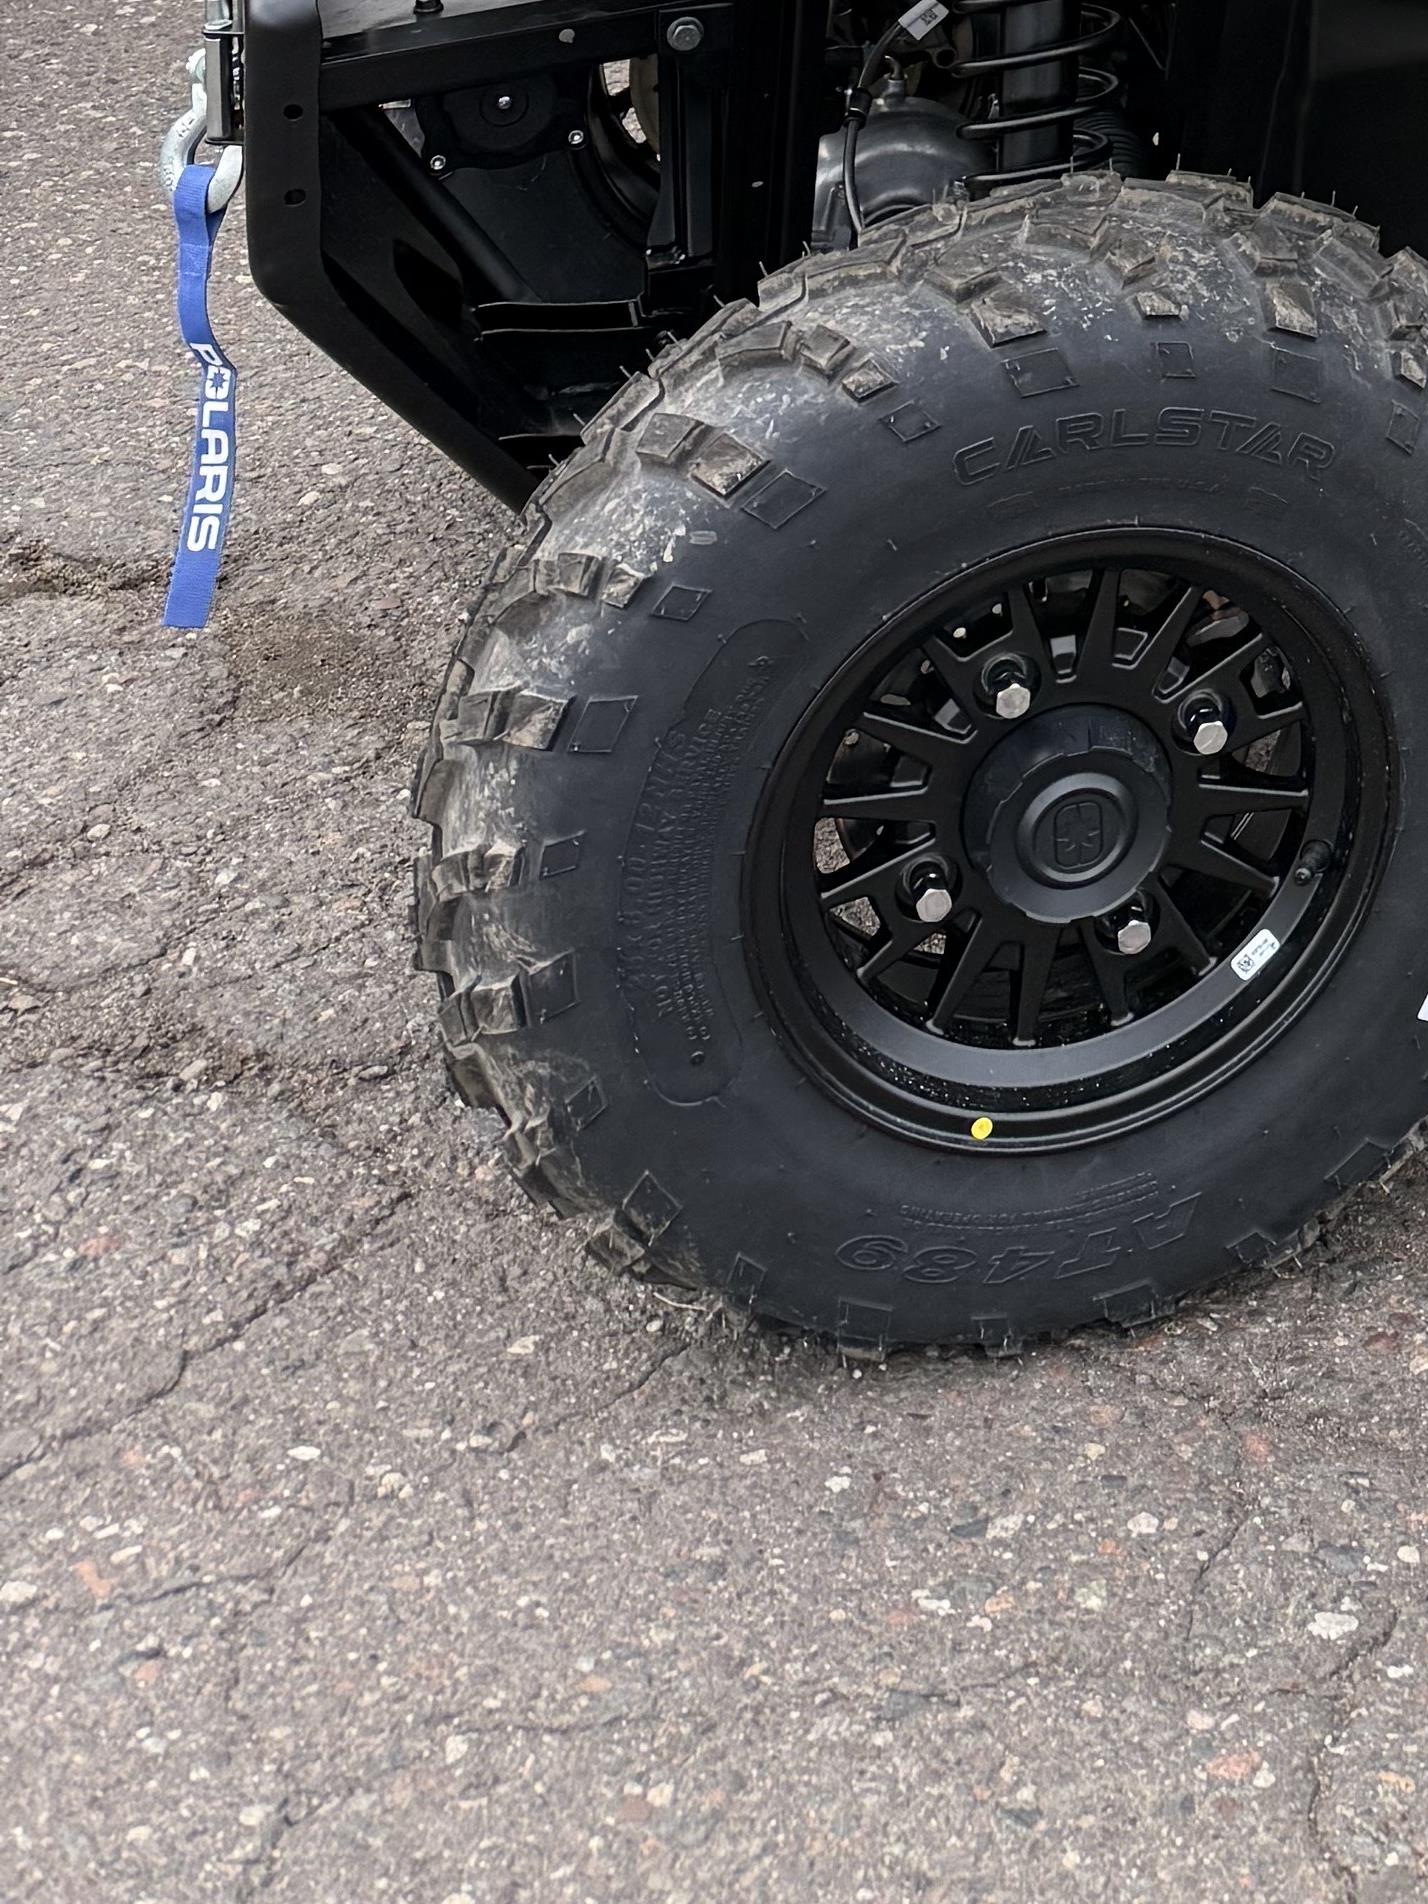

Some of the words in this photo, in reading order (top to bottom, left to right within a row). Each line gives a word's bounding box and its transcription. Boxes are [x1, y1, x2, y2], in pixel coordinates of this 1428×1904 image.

[186, 343, 232, 553] POLARIS
[952, 406, 1337, 485] CARLSTAR
[834, 1191, 1202, 1284] AT489
